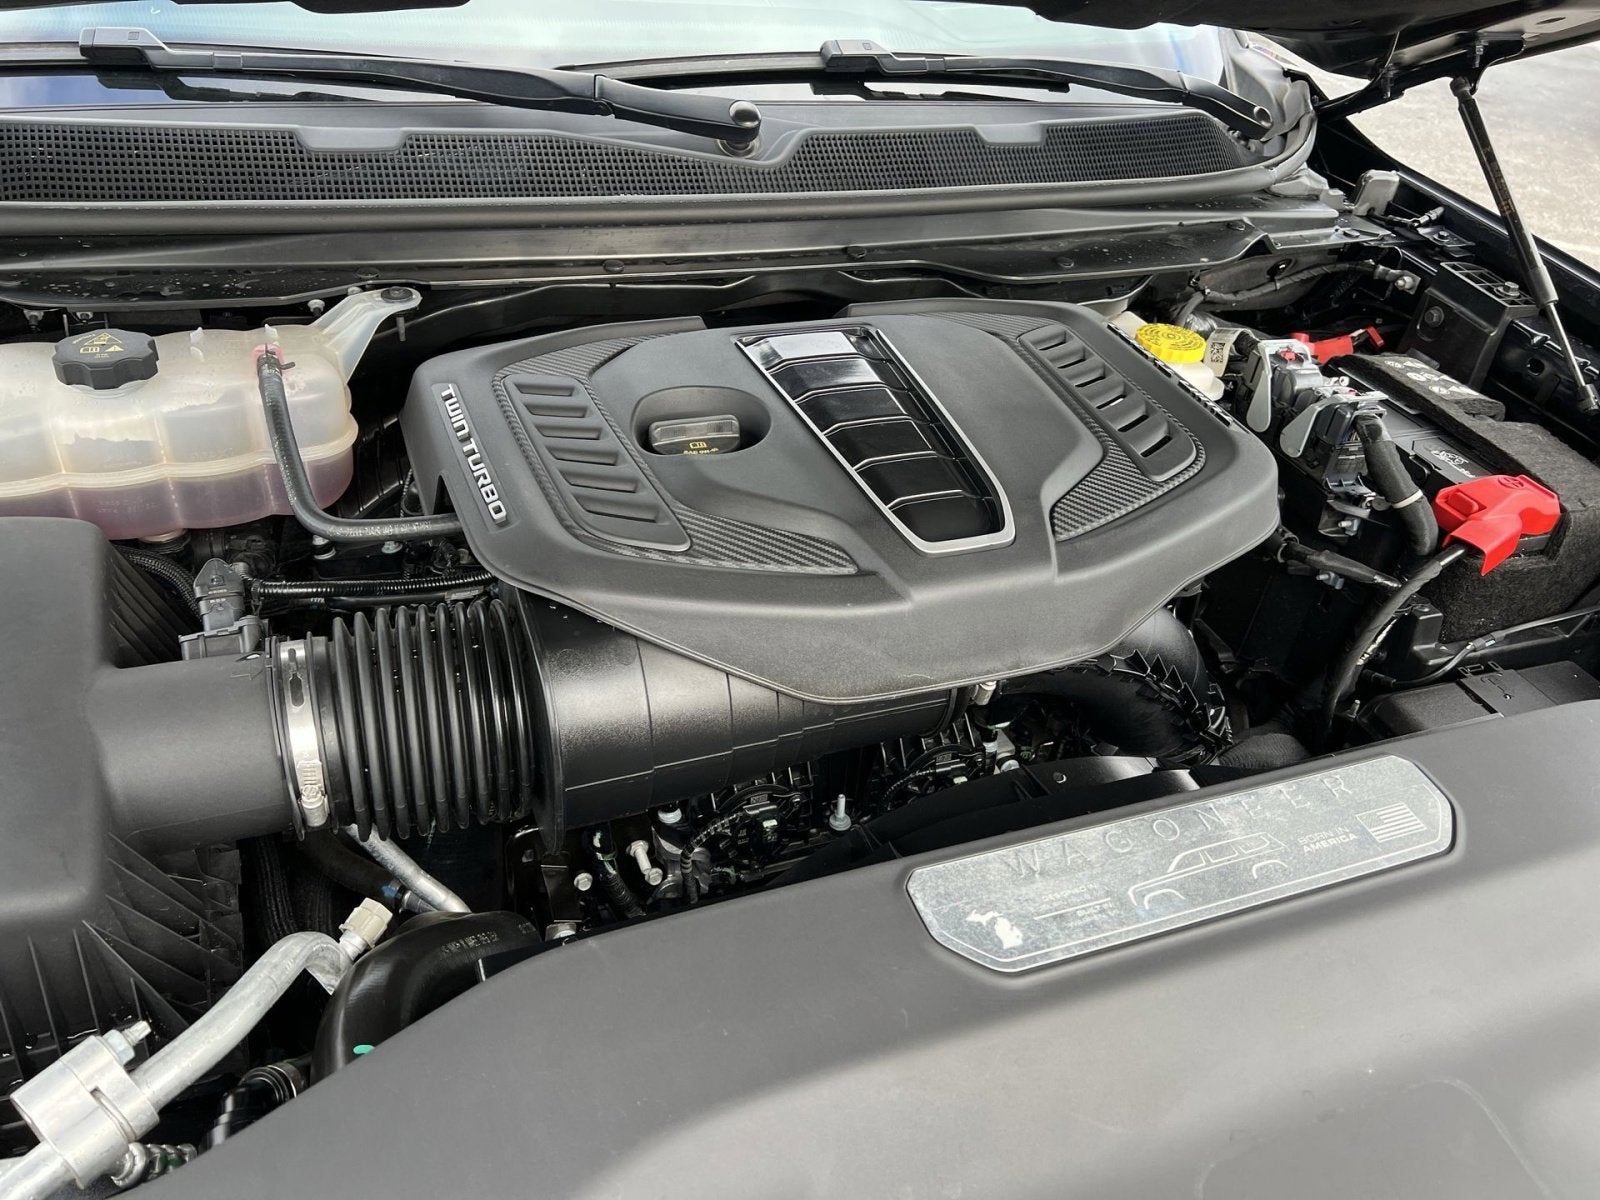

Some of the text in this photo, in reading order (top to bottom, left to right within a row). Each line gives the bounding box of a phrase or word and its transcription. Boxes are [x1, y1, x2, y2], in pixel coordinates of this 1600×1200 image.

[440, 383, 507, 523] TWIN TURBO
[1006, 775, 1352, 879] WAGONEER
[1303, 832, 1357, 855] AMERICA
